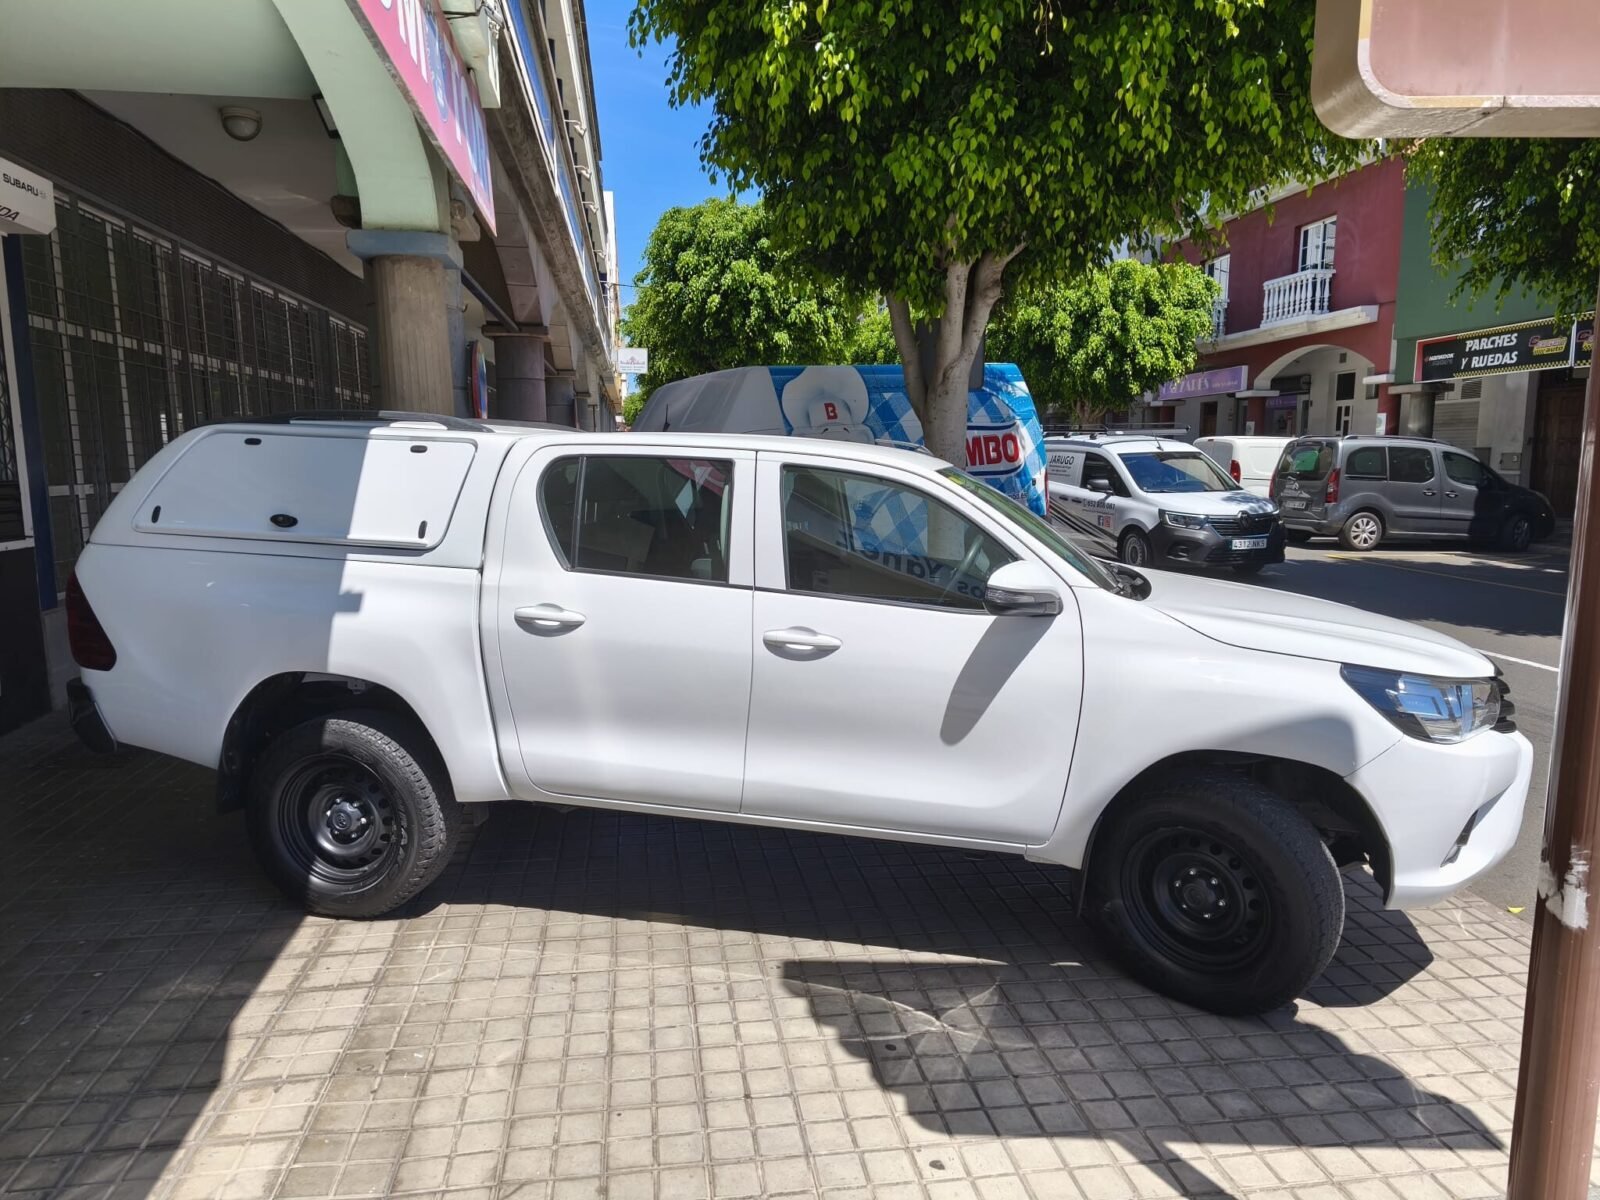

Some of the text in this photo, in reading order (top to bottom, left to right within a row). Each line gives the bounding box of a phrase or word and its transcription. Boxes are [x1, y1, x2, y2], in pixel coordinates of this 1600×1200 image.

[3, 173, 39, 196] SUBARU
[0, 205, 20, 221] DA
[1465, 333, 1518, 352] PARCHES
[1461, 357, 1468, 370] Y
[1471, 352, 1518, 369] RUEDAS
[824, 402, 838, 420] B
[1049, 455, 1075, 465] JARUGO
